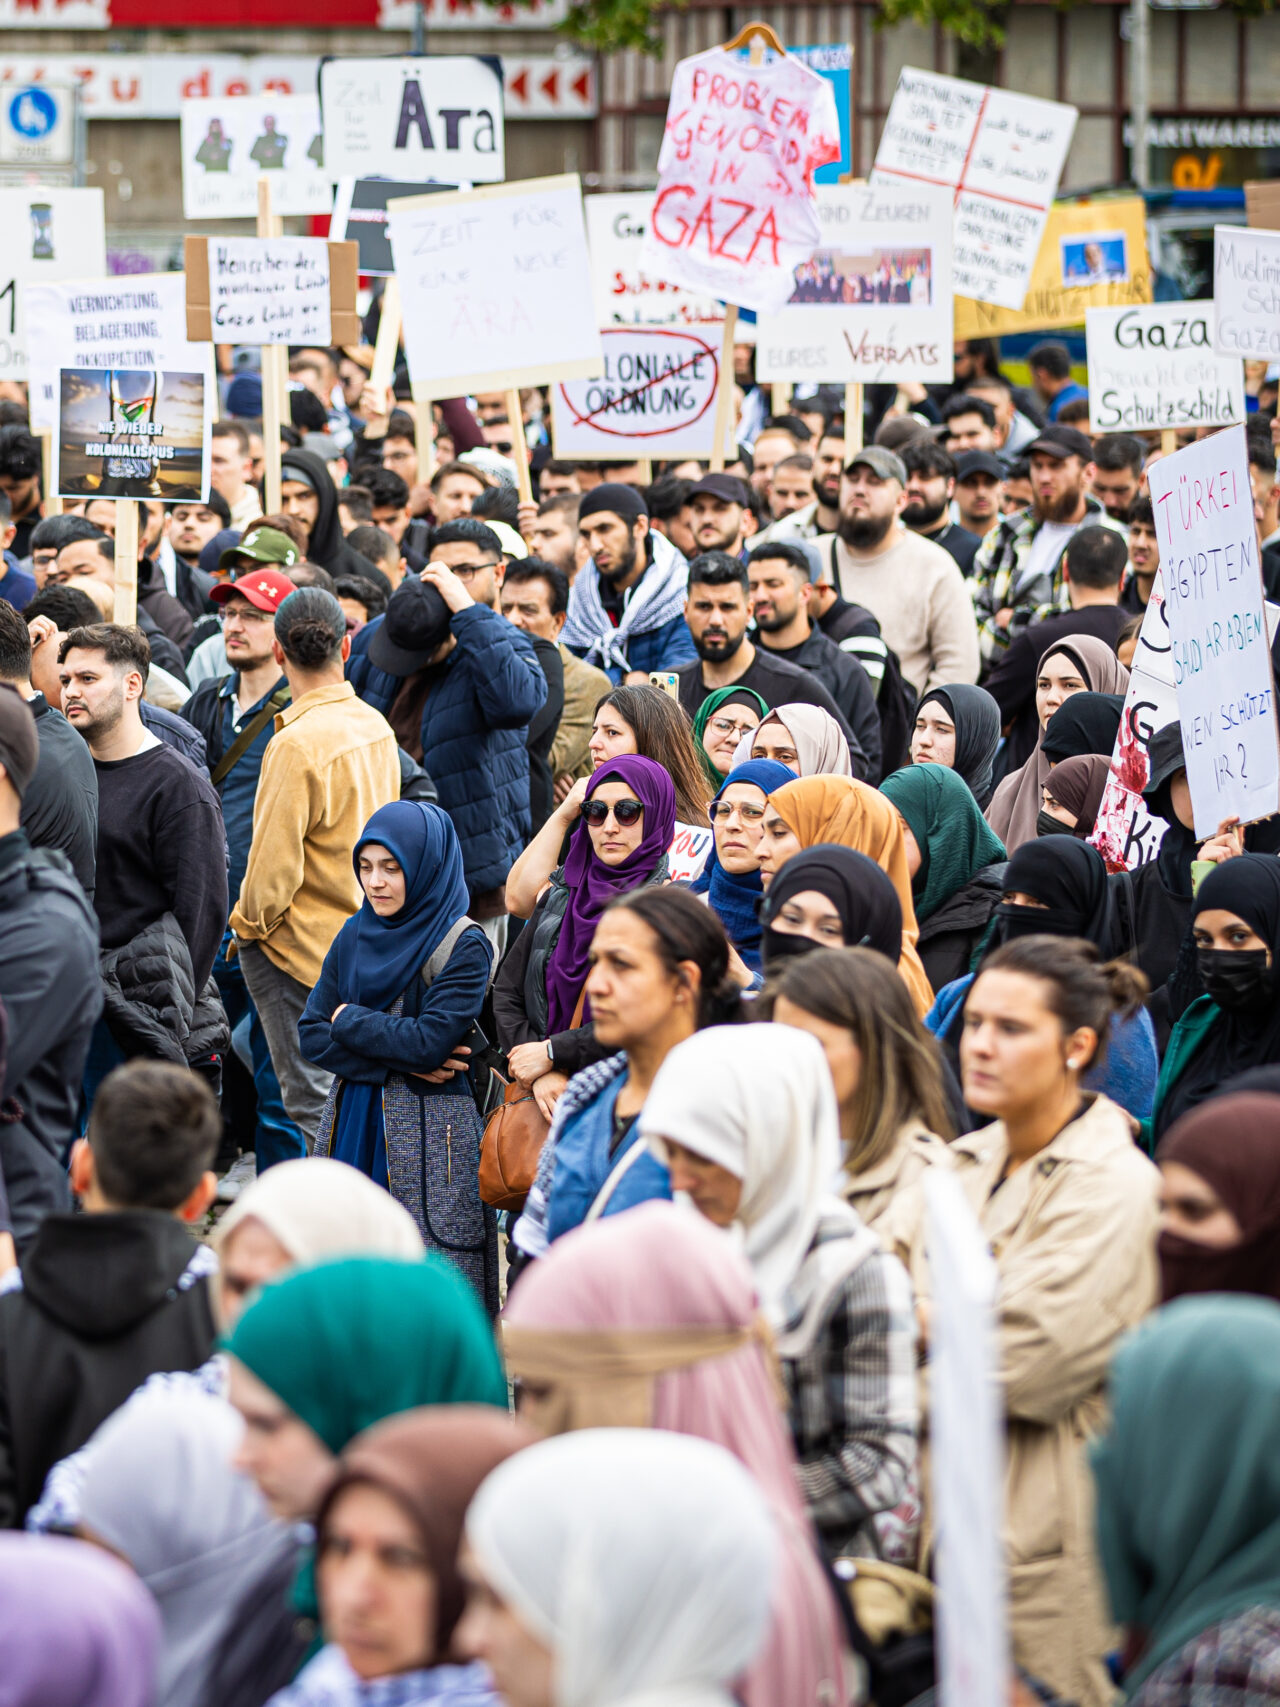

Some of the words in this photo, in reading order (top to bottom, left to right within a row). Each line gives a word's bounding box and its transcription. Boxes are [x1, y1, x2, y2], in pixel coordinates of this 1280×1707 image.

[394, 69, 497, 153] Ära
[692, 69, 808, 137] PROBLEM
[709, 160, 746, 186] IN
[411, 214, 483, 257] ZEIT
[651, 184, 783, 266] GAZA
[1115, 309, 1213, 350] Gaza
[98, 421, 116, 435] NIE
[120, 421, 164, 436] WIEDER
[1097, 388, 1236, 428] Schutzschild
[85, 443, 176, 460] KOLONIALISMUS
[1157, 470, 1238, 545] TÜRKEI
[1167, 537, 1252, 610] ÄGYPTEN
[1181, 711, 1213, 752] WEN
[1220, 689, 1272, 731] SCHÜTZT
